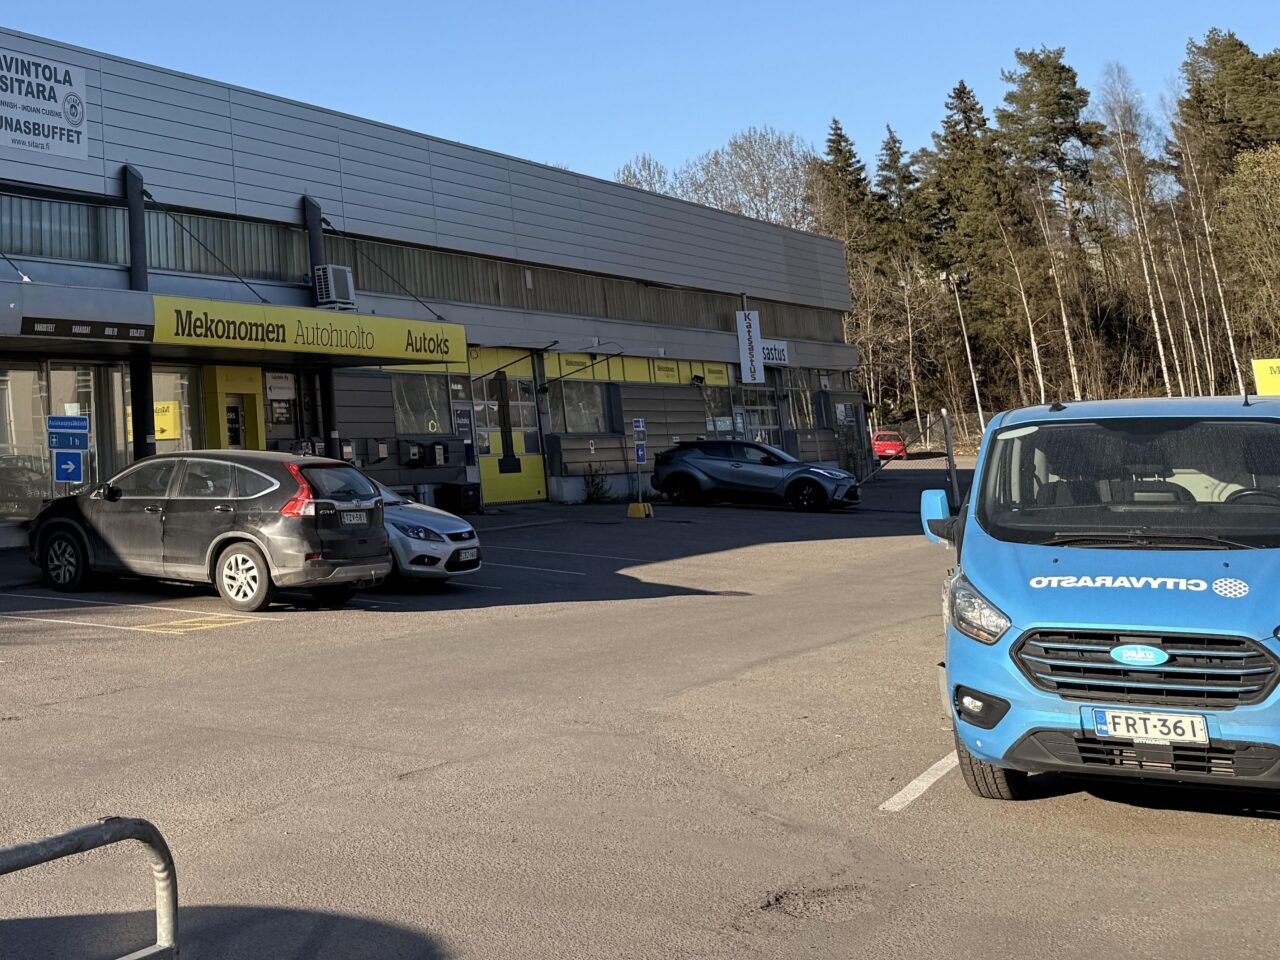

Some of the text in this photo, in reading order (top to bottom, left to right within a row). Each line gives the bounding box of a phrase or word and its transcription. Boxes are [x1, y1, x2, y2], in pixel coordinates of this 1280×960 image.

[0, 75, 58, 103] SITARA
[175, 309, 450, 356] Mekonomen Autohuolto Autoks
[762, 344, 786, 362] sastus
[1111, 715, 1197, 738] FRT-361
